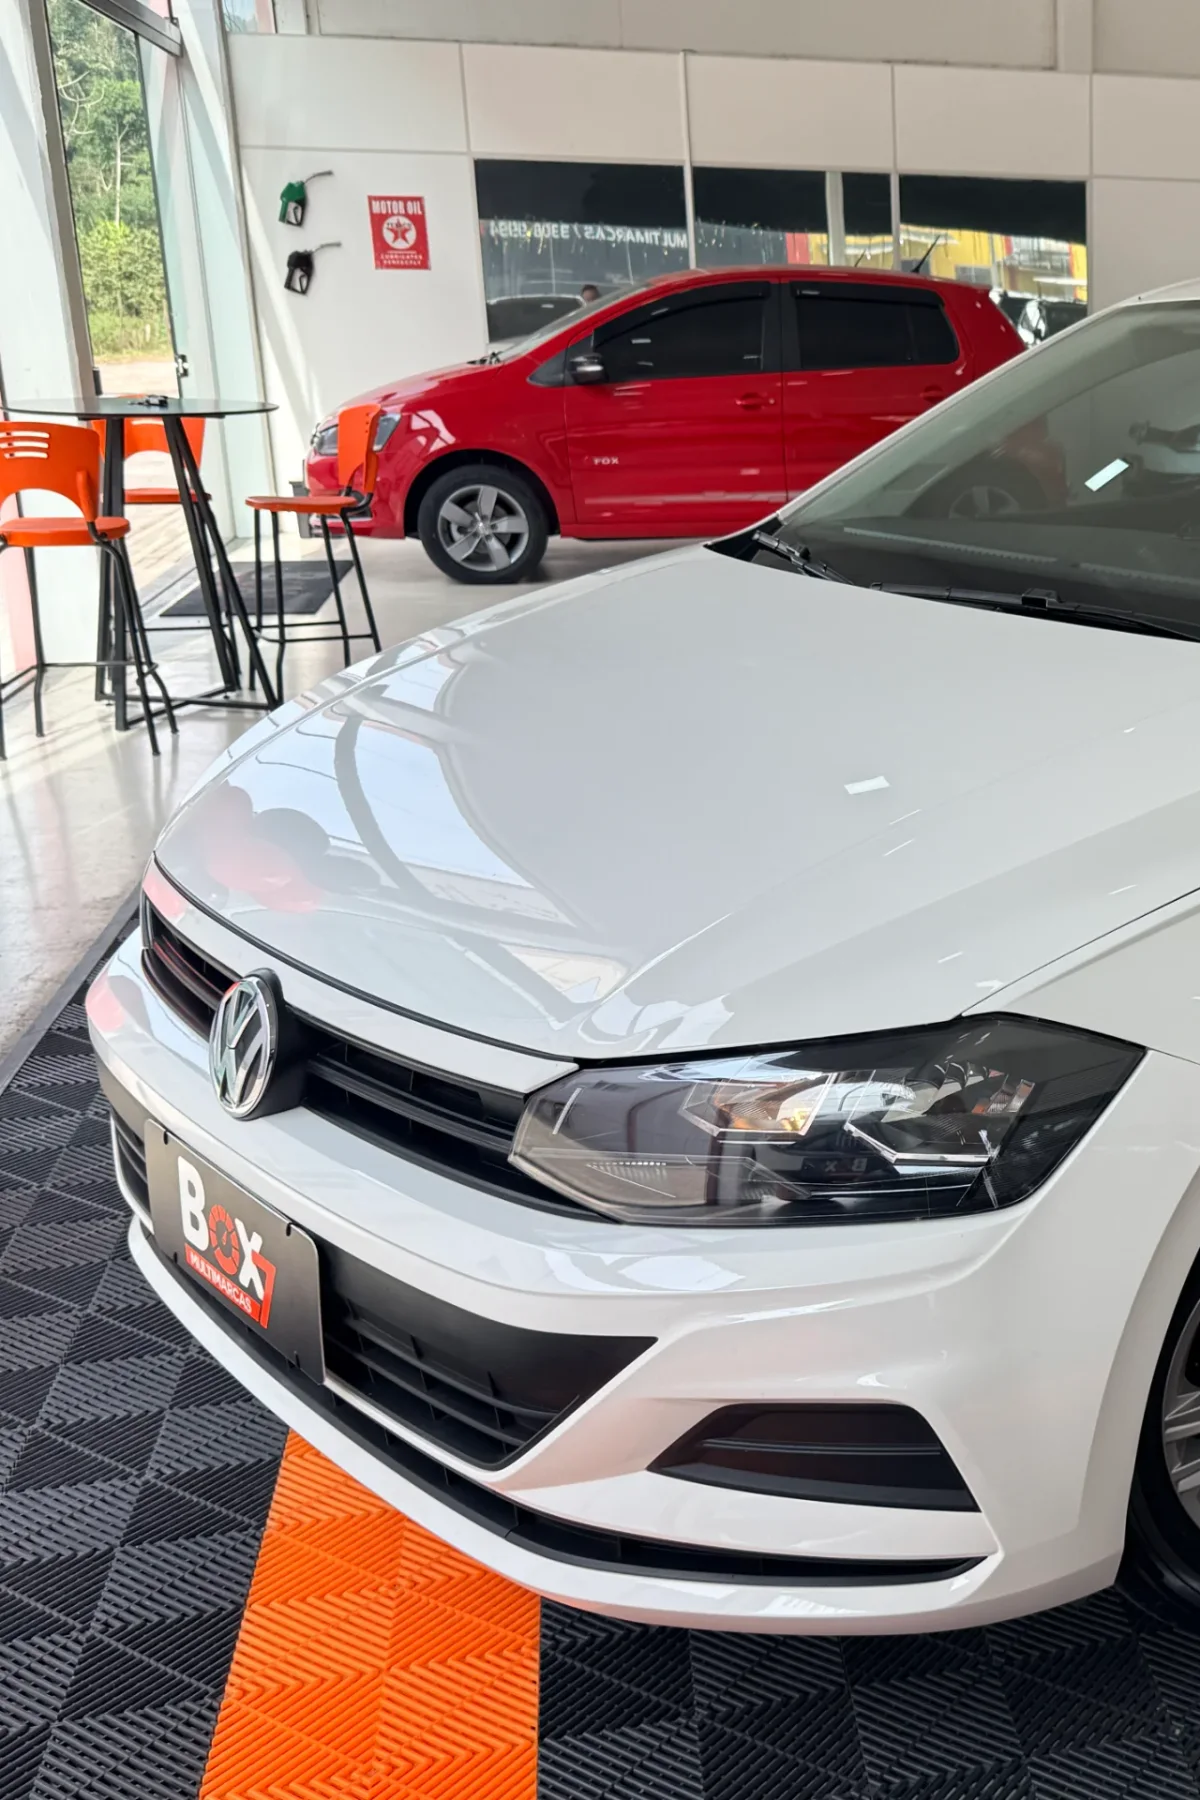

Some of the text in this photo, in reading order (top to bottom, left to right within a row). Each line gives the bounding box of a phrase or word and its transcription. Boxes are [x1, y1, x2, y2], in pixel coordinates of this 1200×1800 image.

[372, 200, 422, 214] MOTOR OIL
[592, 456, 619, 465] FOX
[188, 1250, 252, 1314] MULTIMARCAS
